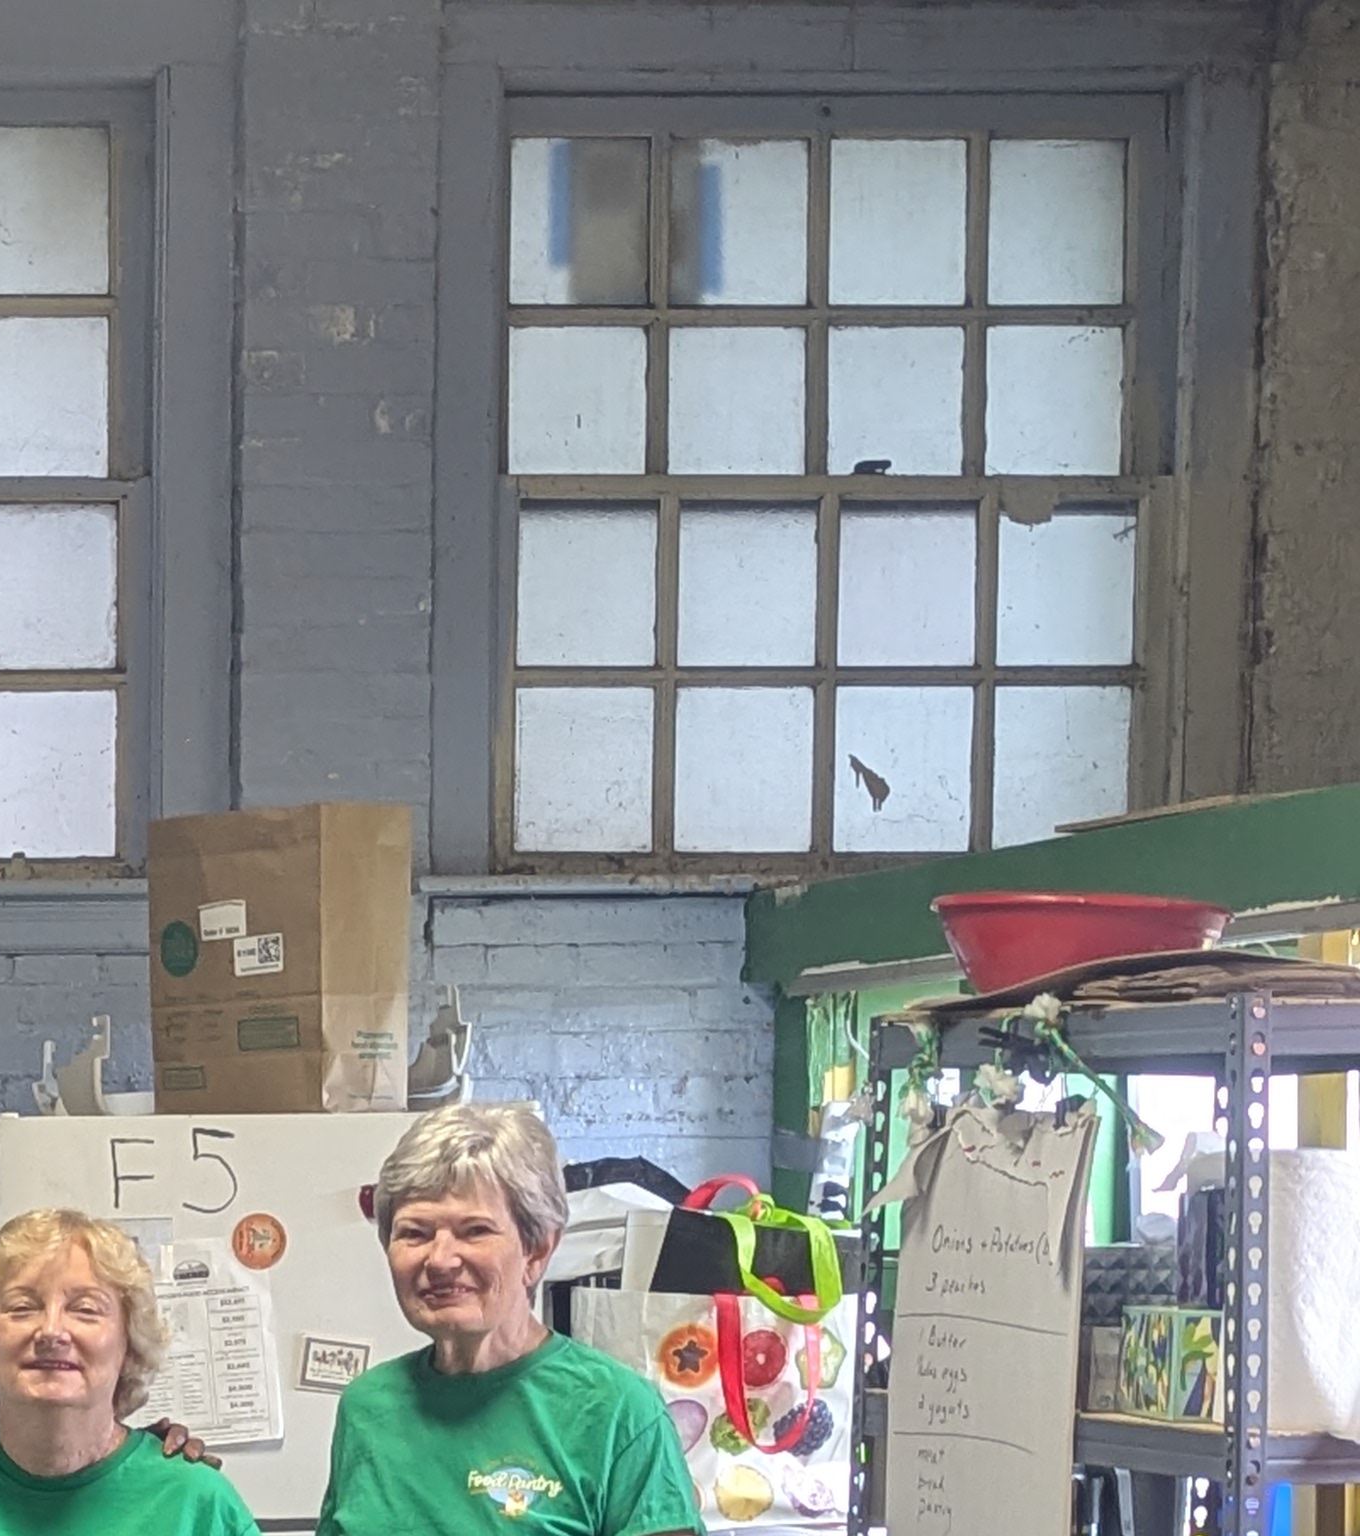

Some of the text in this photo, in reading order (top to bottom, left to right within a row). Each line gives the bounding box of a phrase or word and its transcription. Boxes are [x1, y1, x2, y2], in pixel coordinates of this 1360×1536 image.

[941, 1367, 967, 1394] eggs
[467, 1470, 563, 1498] Food Pantry
